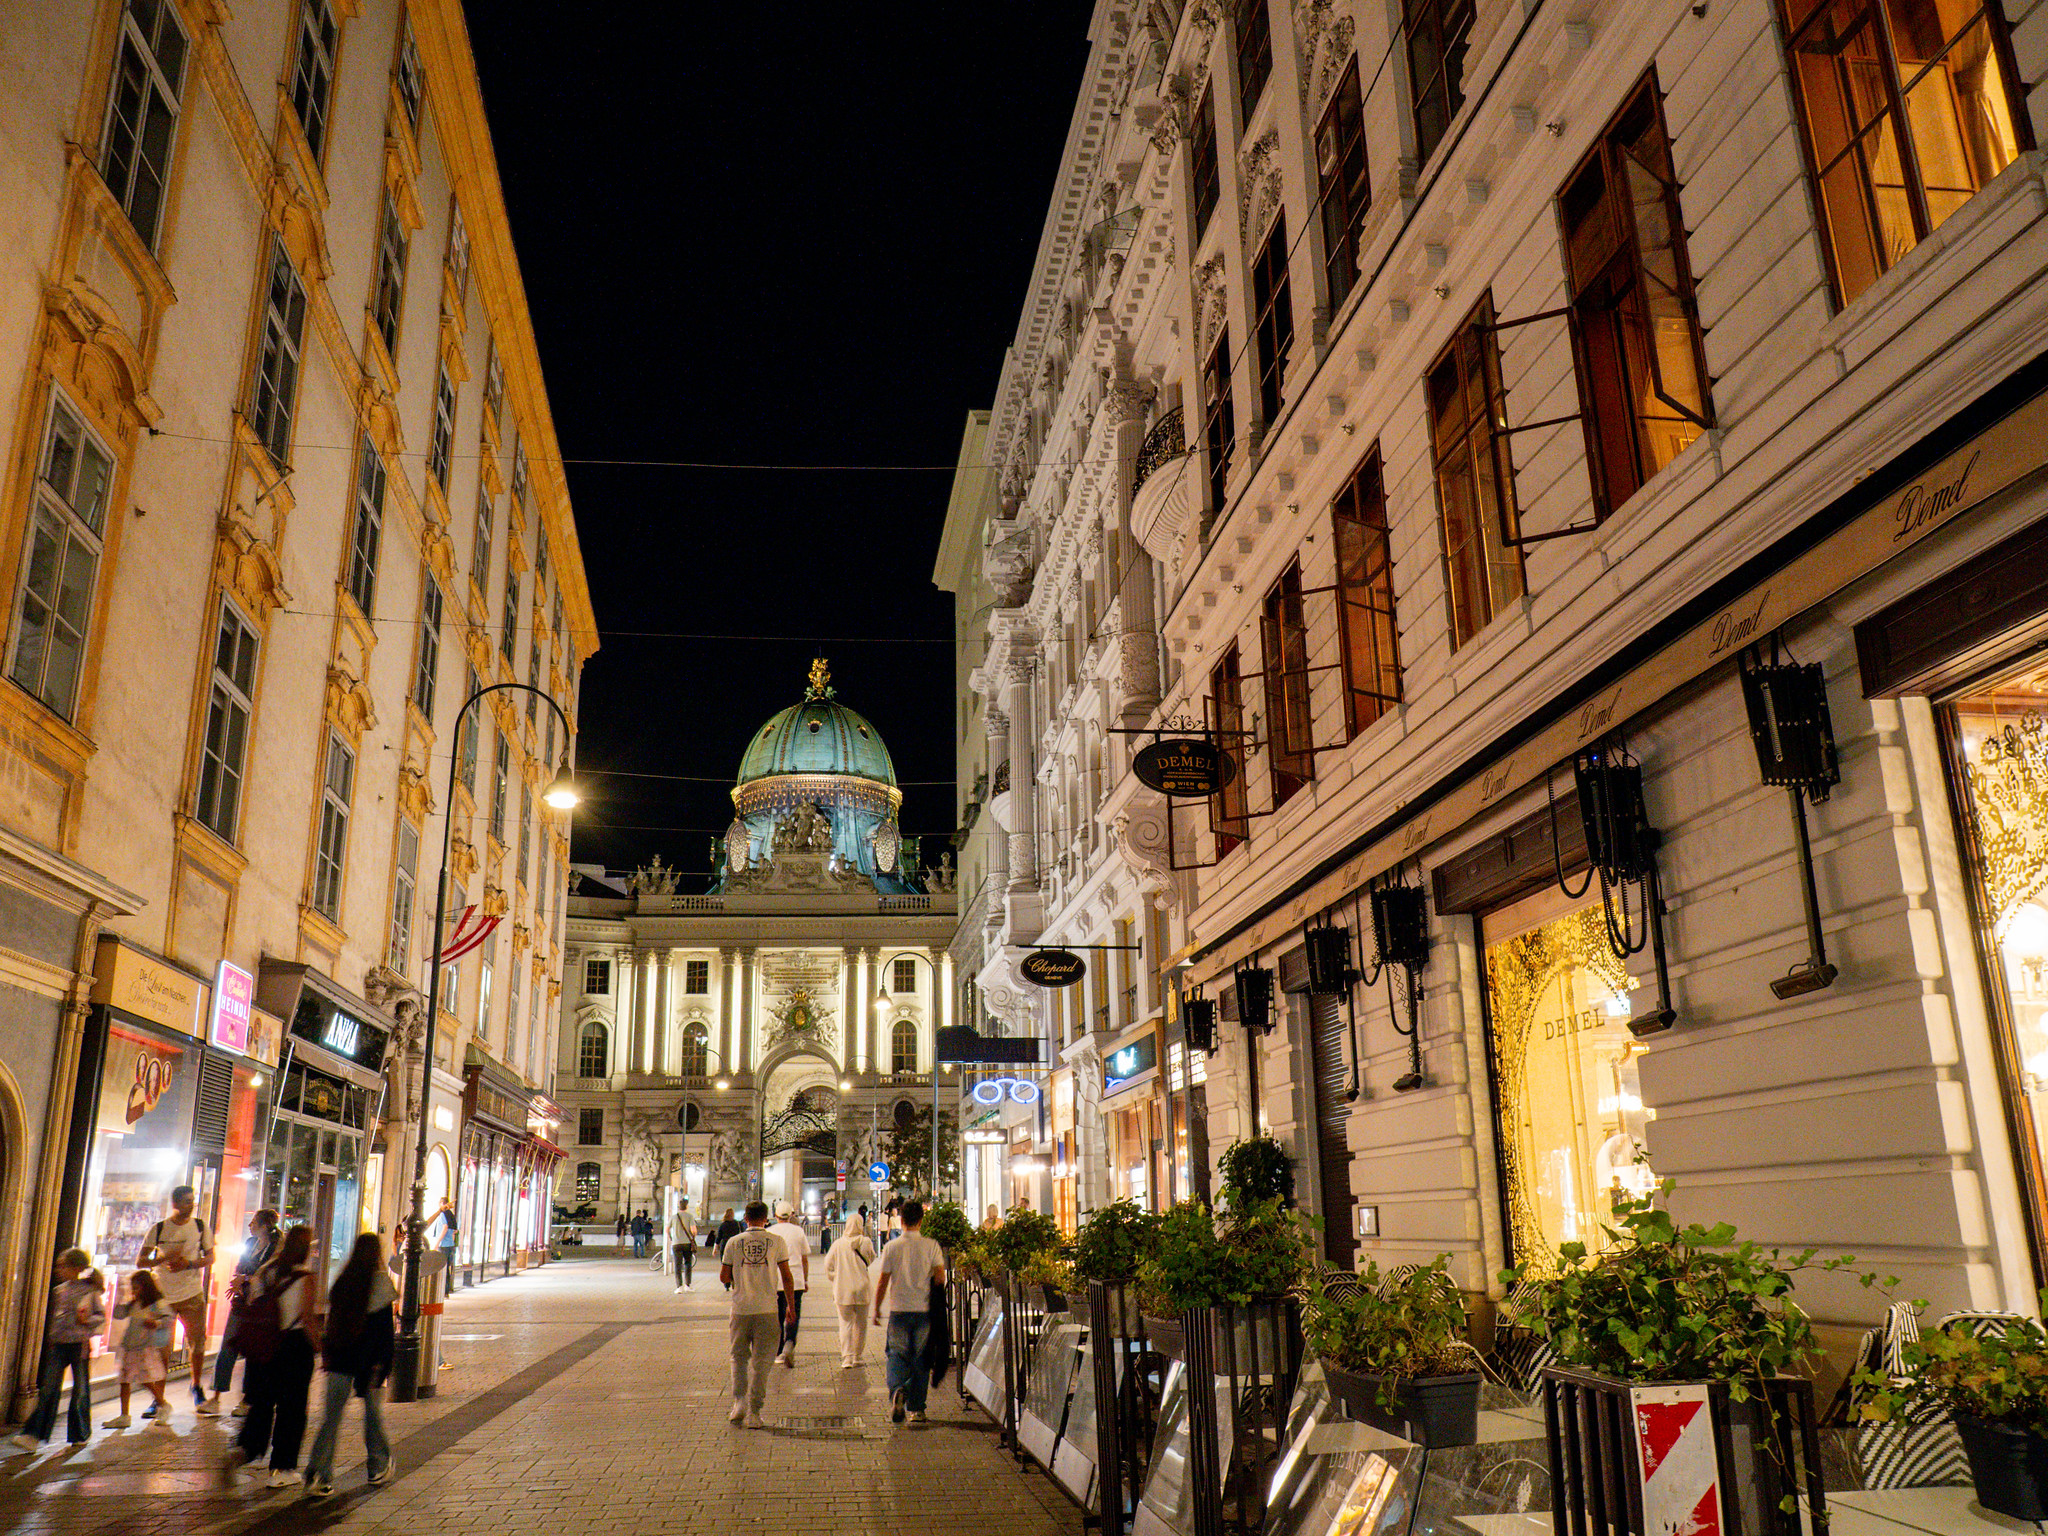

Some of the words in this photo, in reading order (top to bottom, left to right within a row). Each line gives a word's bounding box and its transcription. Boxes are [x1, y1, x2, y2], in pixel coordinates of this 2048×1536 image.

[1893, 450, 1981, 543] Demel
[1709, 590, 1771, 658] Demel
[1577, 687, 1623, 742] Demel
[1156, 755, 1215, 771] DEMEL
[1481, 760, 1515, 803] Demel
[1027, 957, 1079, 976] Chopard
[220, 994, 248, 1021] HEINDL
[1543, 1008, 1606, 1041] DEMEL
[747, 1245, 763, 1254] 135
